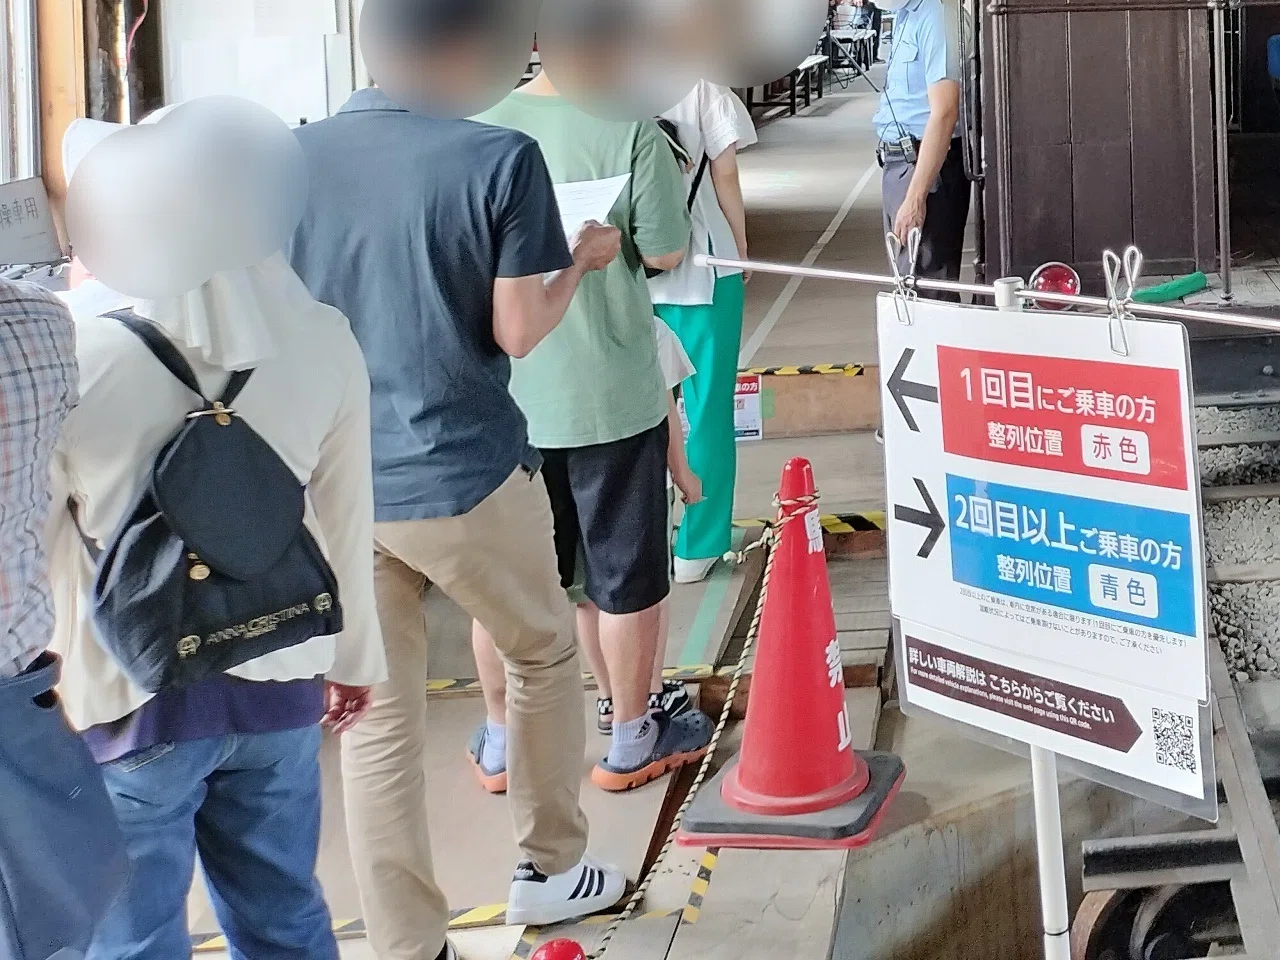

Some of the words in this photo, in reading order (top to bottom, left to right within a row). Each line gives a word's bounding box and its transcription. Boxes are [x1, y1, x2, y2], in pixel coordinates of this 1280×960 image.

[960, 367, 1157, 424] 1回目にご乗車の方
[987, 420, 1065, 458] 整列位置
[1092, 432, 1139, 464] 赤色
[953, 496, 1183, 571] 2回目以上ご乗車の方
[997, 553, 1074, 595] 整列位置
[1100, 570, 1147, 606] 青色
[908, 646, 988, 687] 詳しい車両解説は
[988, 673, 1116, 724] こちらからご覧ください
